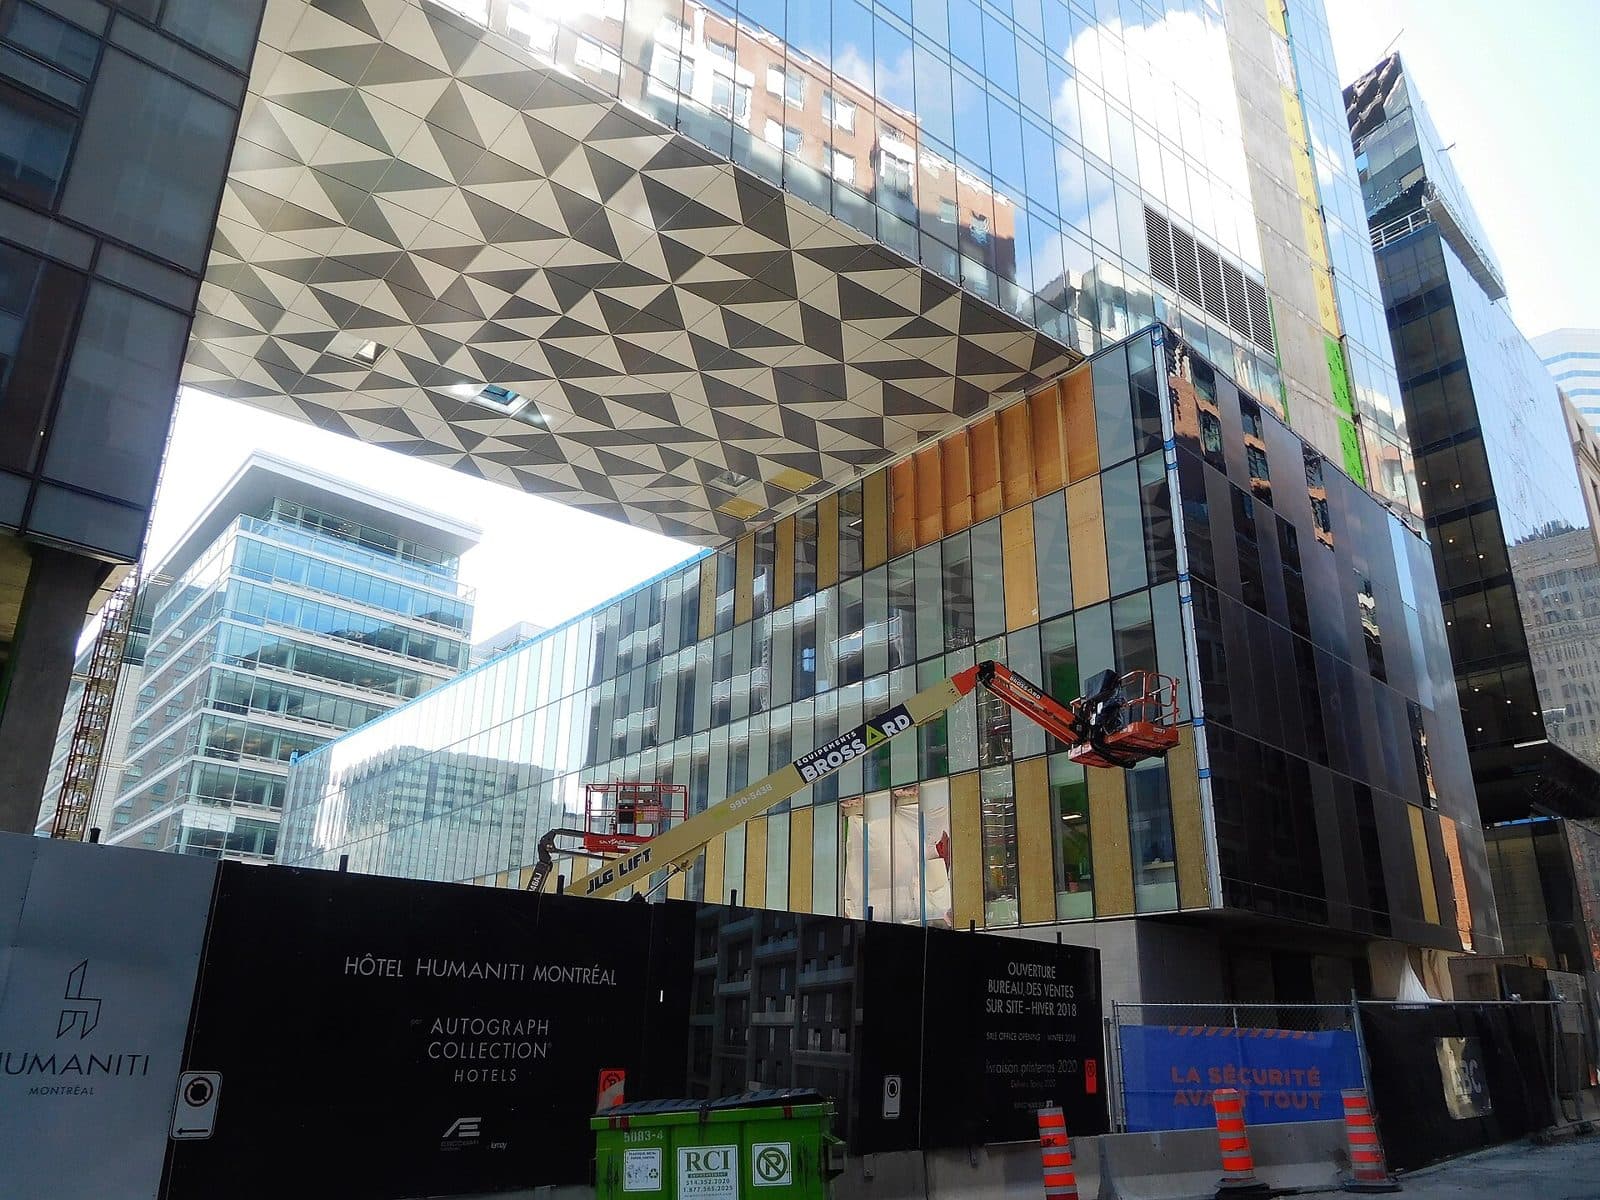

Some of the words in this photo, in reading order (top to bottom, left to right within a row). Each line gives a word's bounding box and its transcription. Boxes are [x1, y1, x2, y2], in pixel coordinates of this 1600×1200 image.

[586, 869, 614, 895] JLG
[618, 847, 652, 877] LIFT
[344, 953, 404, 978] HÔTEL
[416, 958, 525, 981] HUMANITI
[532, 963, 617, 986] MONTRÉAL
[1007, 961, 1056, 979] OUVERTURE
[988, 979, 1023, 995] BUREAU
[1026, 982, 1042, 996] DES
[1043, 984, 1074, 998] VENTES
[985, 998, 1003, 1013] SUR
[1005, 999, 1024, 1014] SITE
[1056, 1002, 1077, 1016] 2018
[430, 1017, 549, 1036] AUTOGRAPH
[428, 1041, 547, 1059] COLLECTION
[0, 1052, 149, 1076] UMANITI
[454, 1068, 517, 1082] HOTELS
[1171, 1066, 1200, 1084] LA
[1208, 1063, 1321, 1087] SÉCURITÉ
[1259, 1090, 1323, 1110] TOUT
[684, 1150, 731, 1172] RCI
